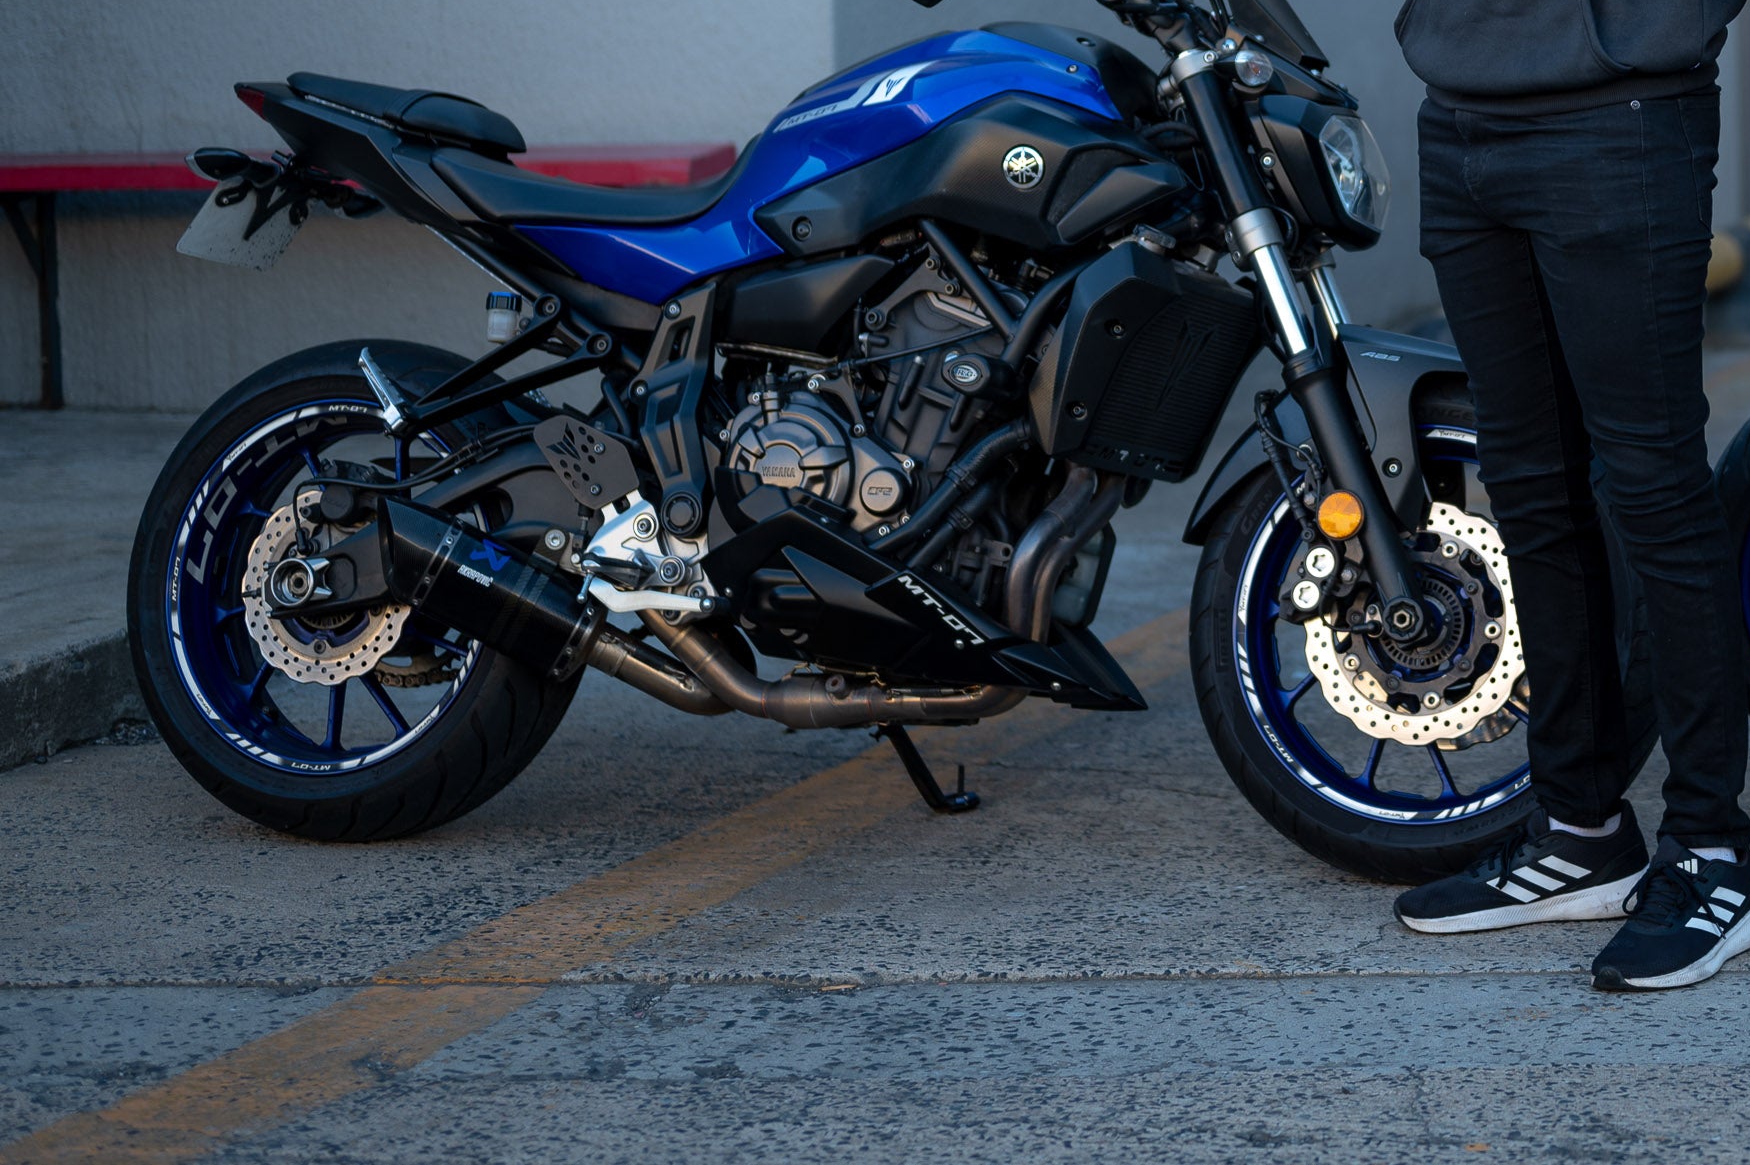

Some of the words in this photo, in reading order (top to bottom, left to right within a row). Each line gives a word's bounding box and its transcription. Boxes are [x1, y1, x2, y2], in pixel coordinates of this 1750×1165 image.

[328, 403, 368, 414] MT-07
[761, 465, 796, 478] YAMAHA
[171, 556, 181, 602] MT-07
[897, 574, 986, 647] MT-07
[1262, 724, 1294, 764] MT-07
[290, 761, 332, 772] MT-07
